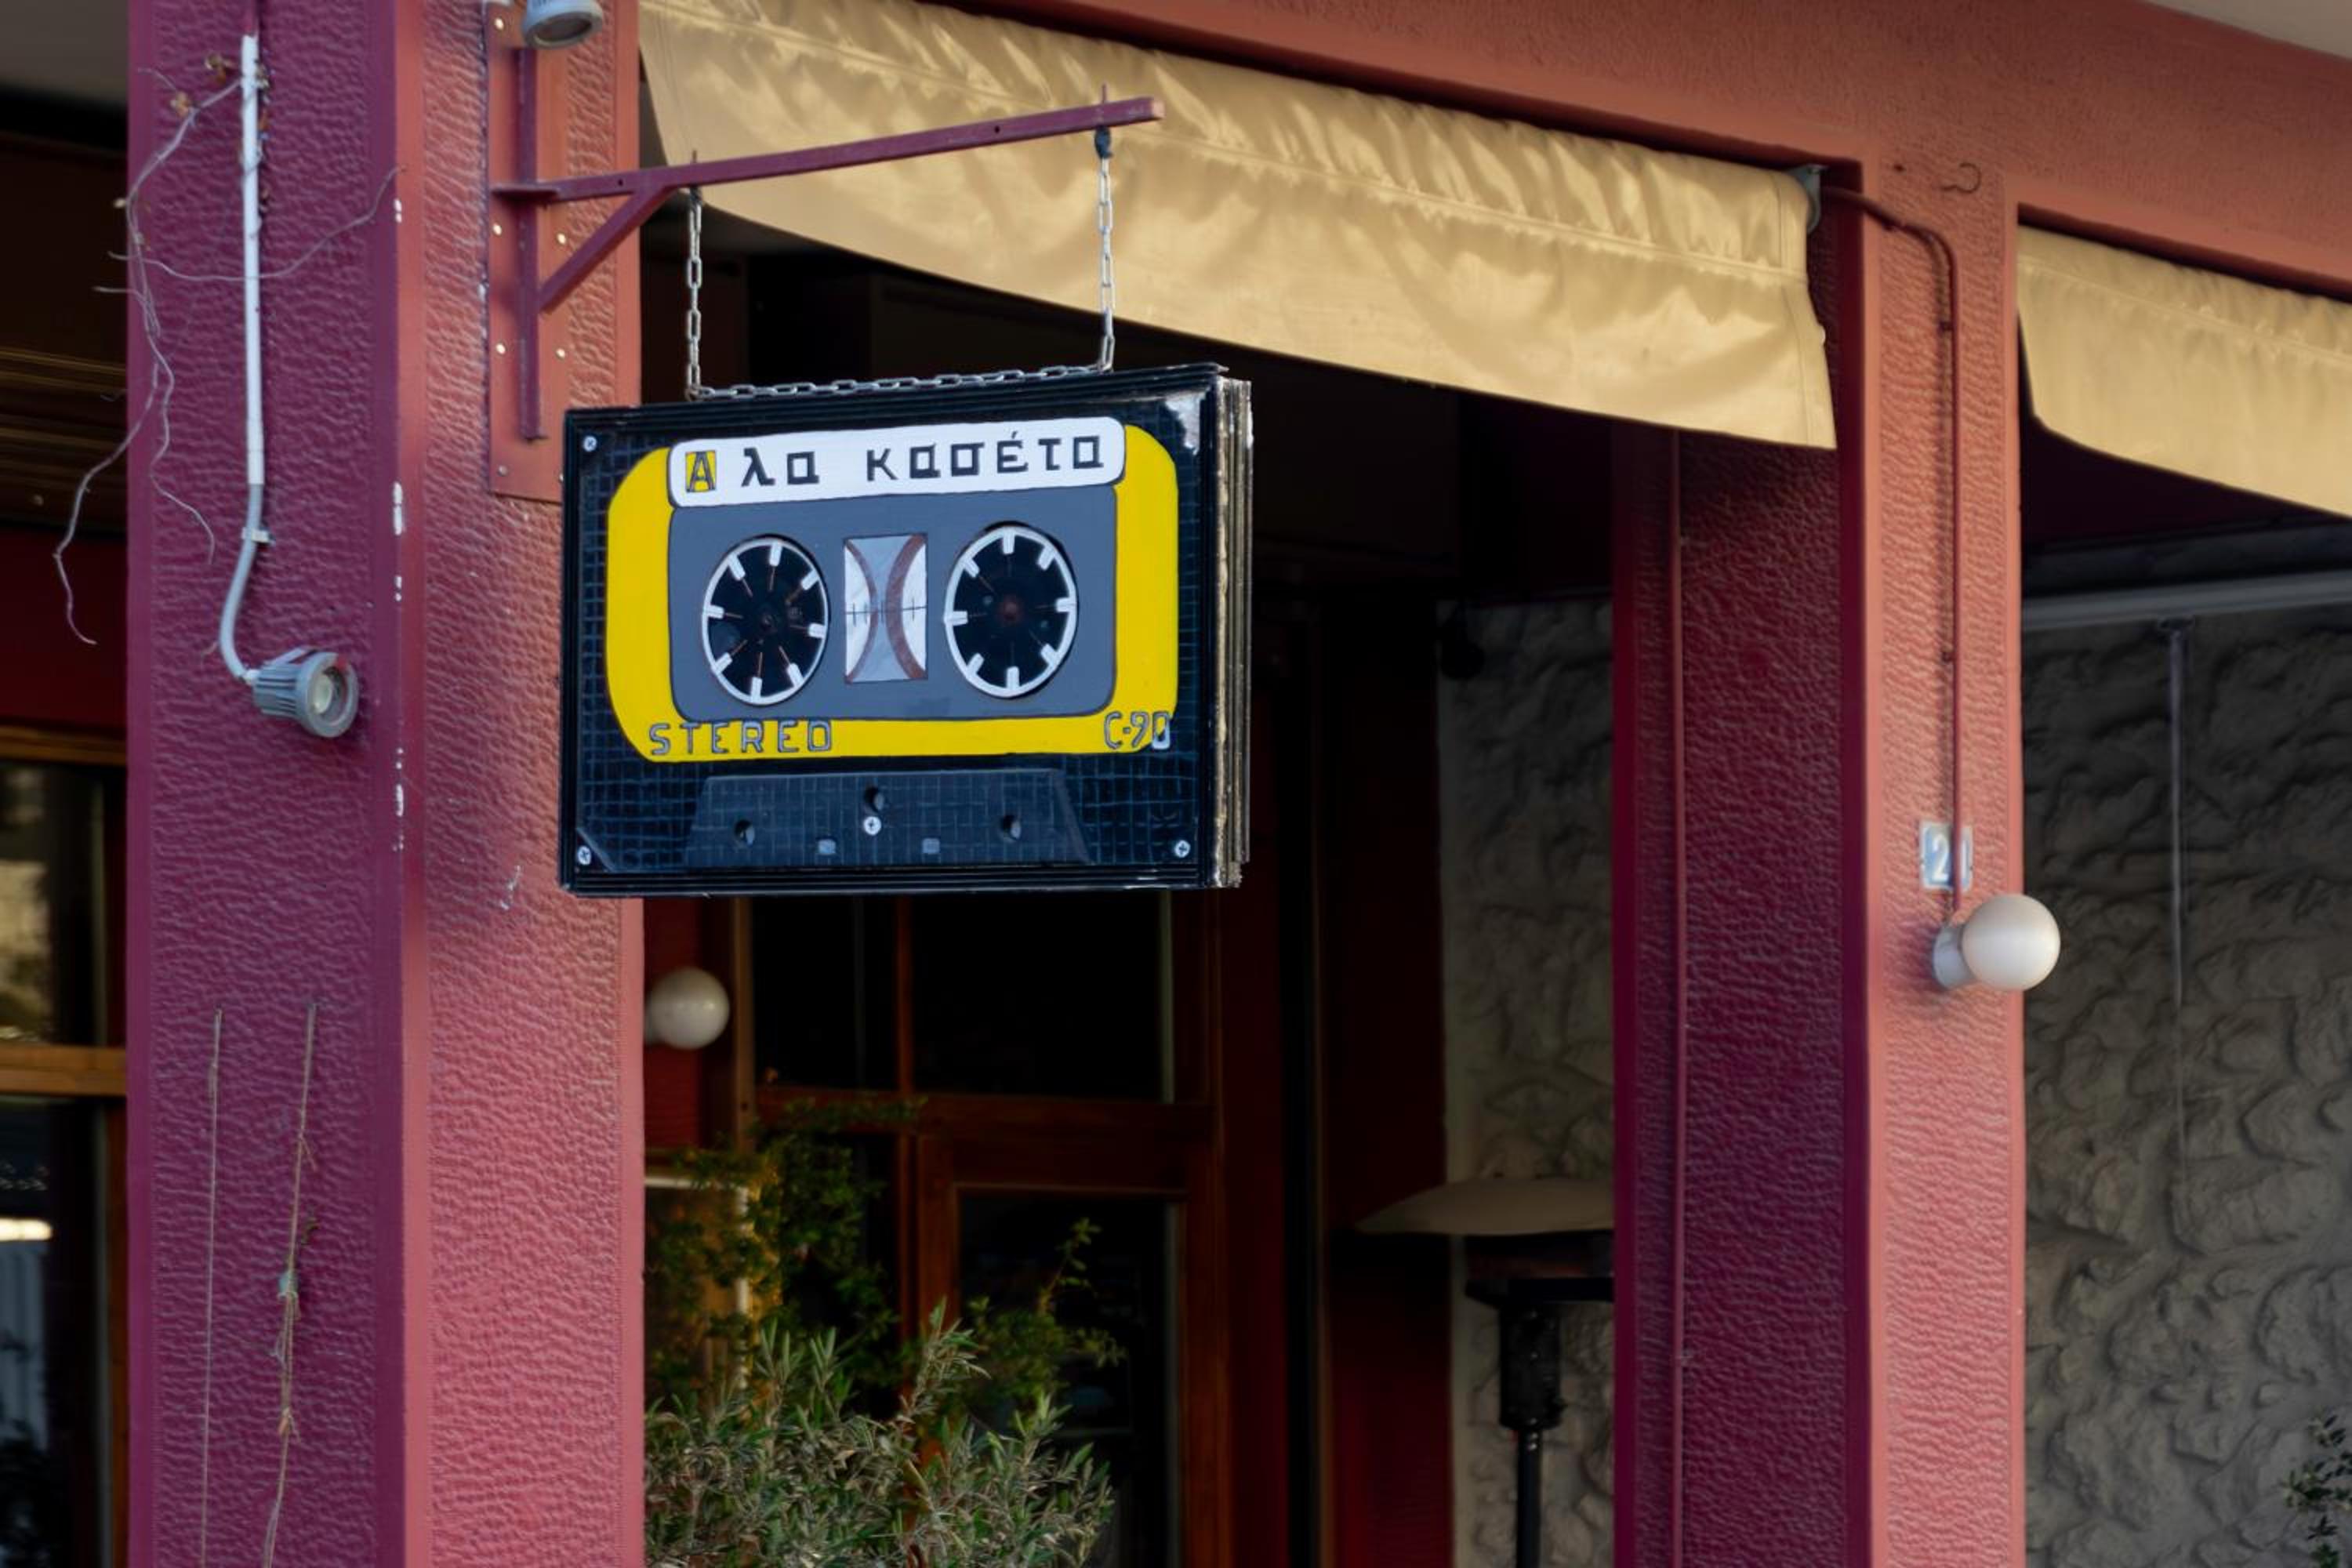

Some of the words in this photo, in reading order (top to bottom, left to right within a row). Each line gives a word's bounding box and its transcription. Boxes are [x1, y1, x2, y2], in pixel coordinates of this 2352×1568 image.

[741, 447, 819, 487] λα
[866, 430, 1104, 481] κασέτα
[648, 719, 832, 755] STEREO
